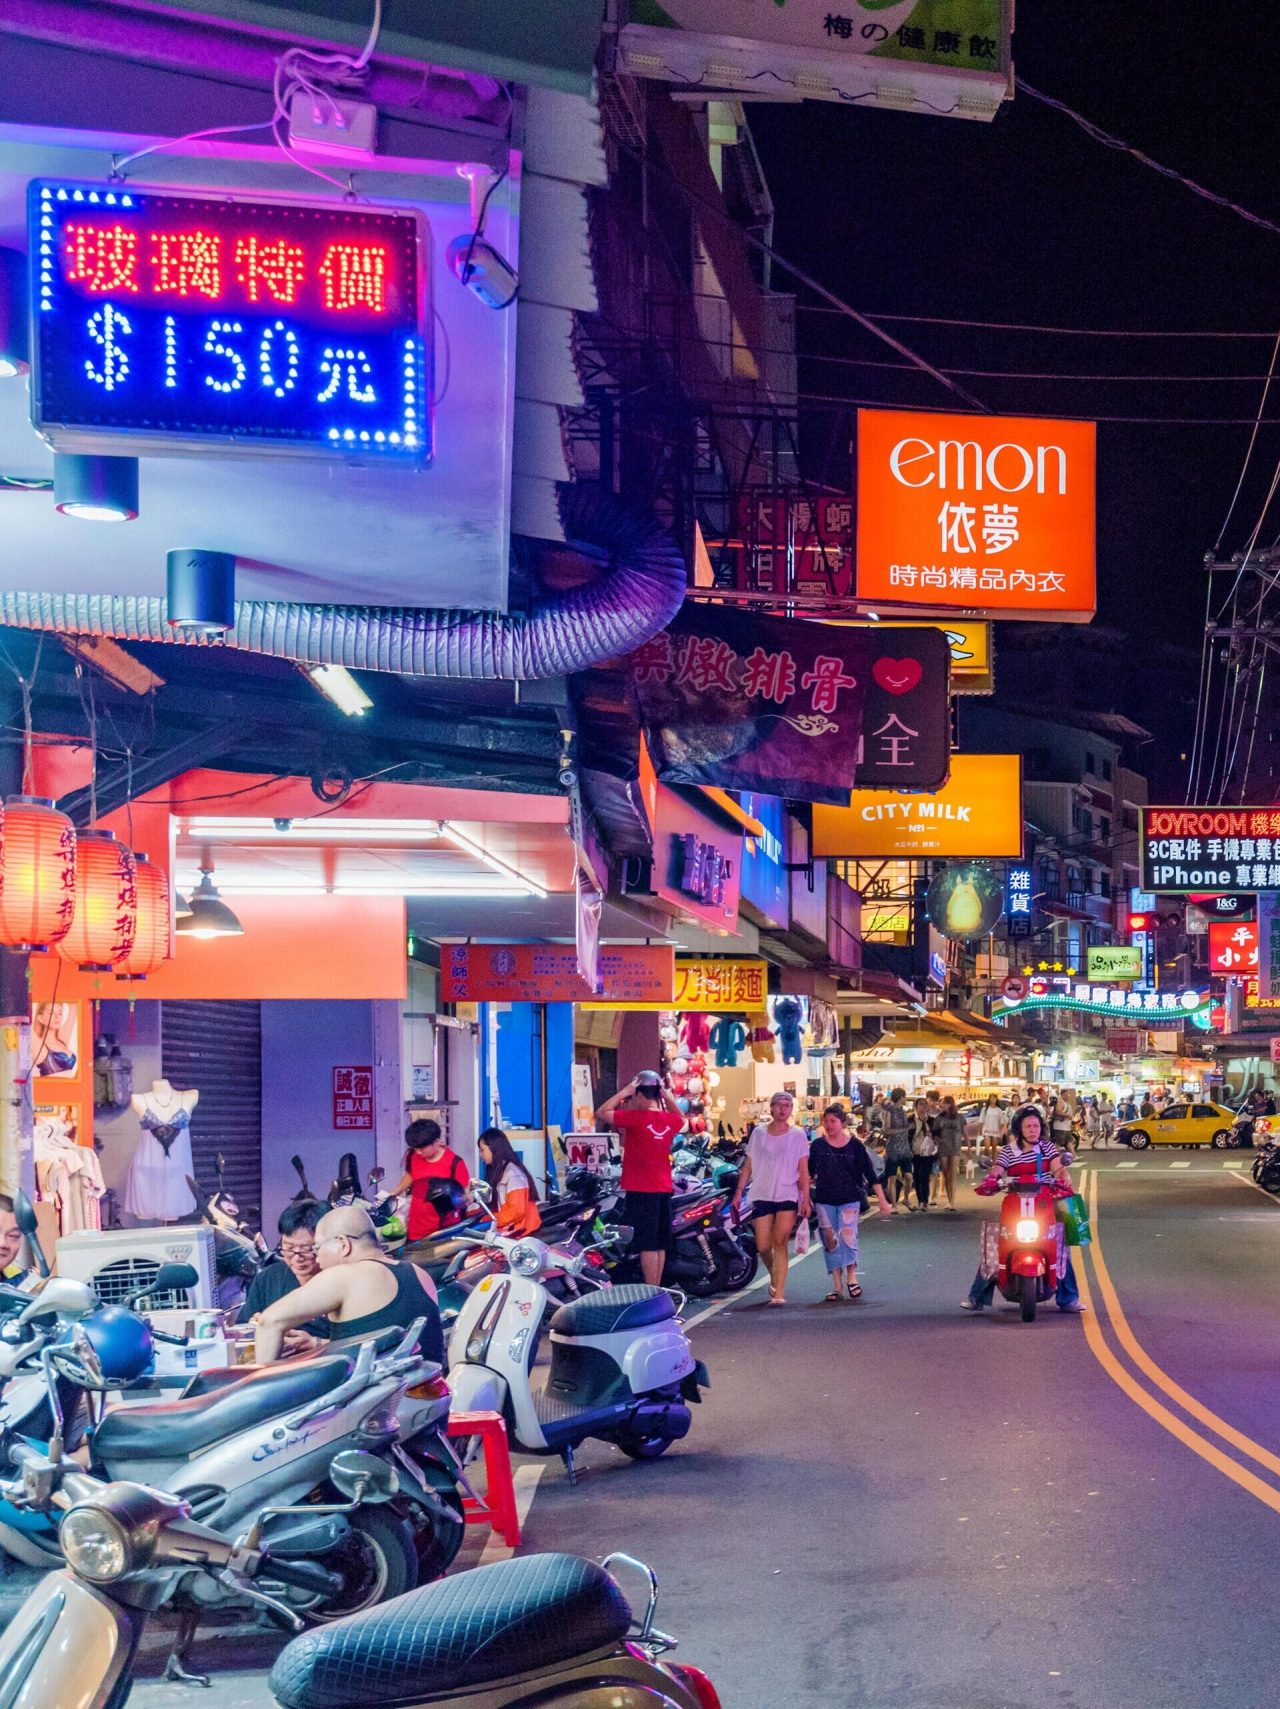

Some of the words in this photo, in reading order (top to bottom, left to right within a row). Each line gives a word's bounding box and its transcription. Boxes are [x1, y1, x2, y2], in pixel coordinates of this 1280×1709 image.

[822, 13, 997, 60] 梅の健康飲
[85, 303, 376, 402] $150元
[889, 437, 1067, 495] emon
[938, 500, 1019, 554] 依夢
[889, 564, 1066, 594] 時尚精品內衣
[861, 802, 912, 822] CITY
[918, 802, 973, 822] MILK
[1148, 813, 1247, 835] JOYROOM
[1148, 838, 1202, 861] 3C配件
[1153, 866, 1231, 885] iPhone
[1216, 898, 1237, 909] J&G
[675, 965, 763, 1003] 刀削麵
